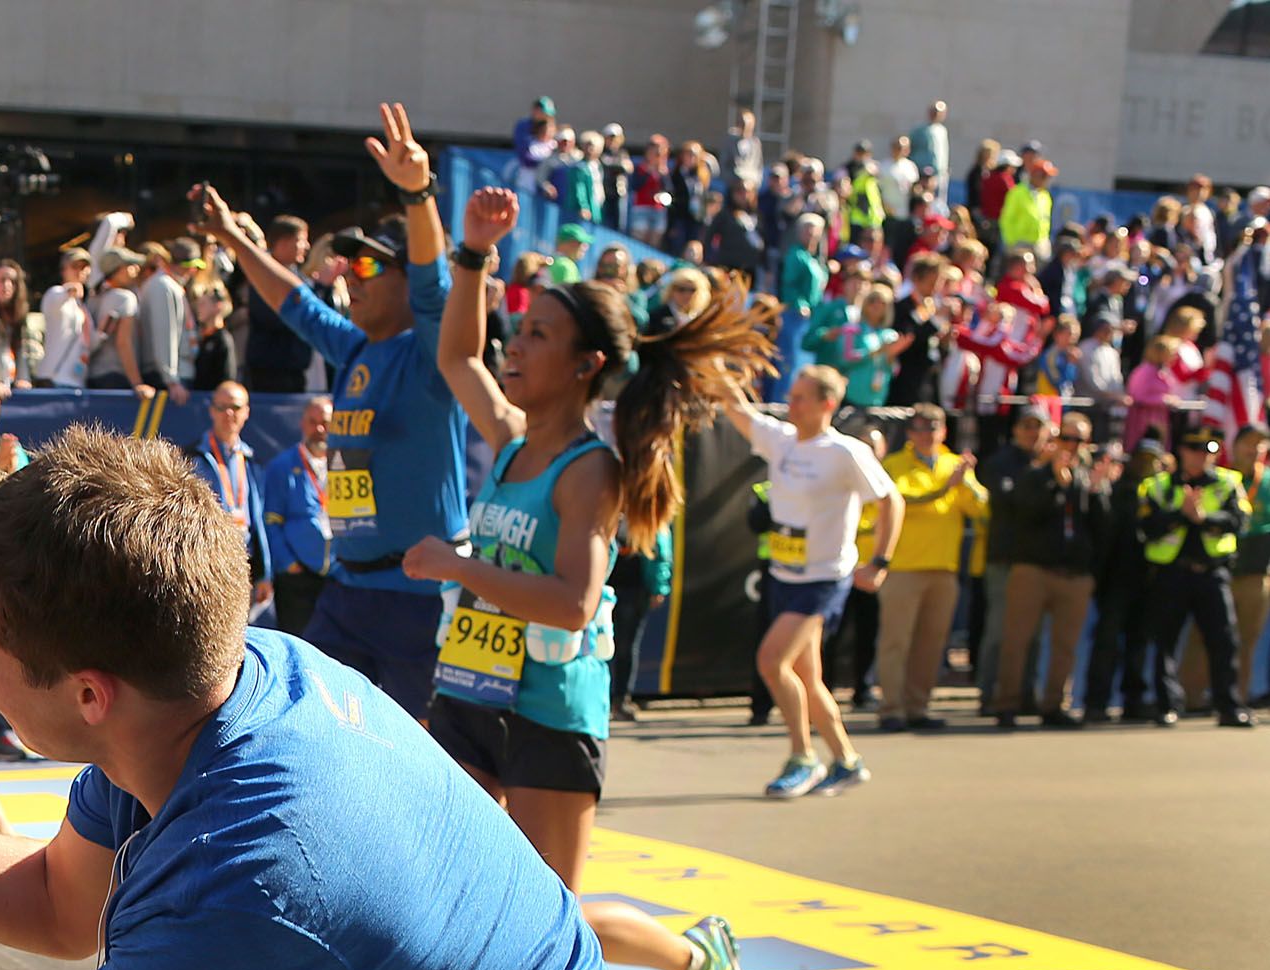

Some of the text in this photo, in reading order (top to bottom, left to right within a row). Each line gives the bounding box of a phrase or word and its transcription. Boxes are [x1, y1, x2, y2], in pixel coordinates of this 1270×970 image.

[1120, 95, 1270, 144] THE B
[445, 615, 525, 657] 9463
